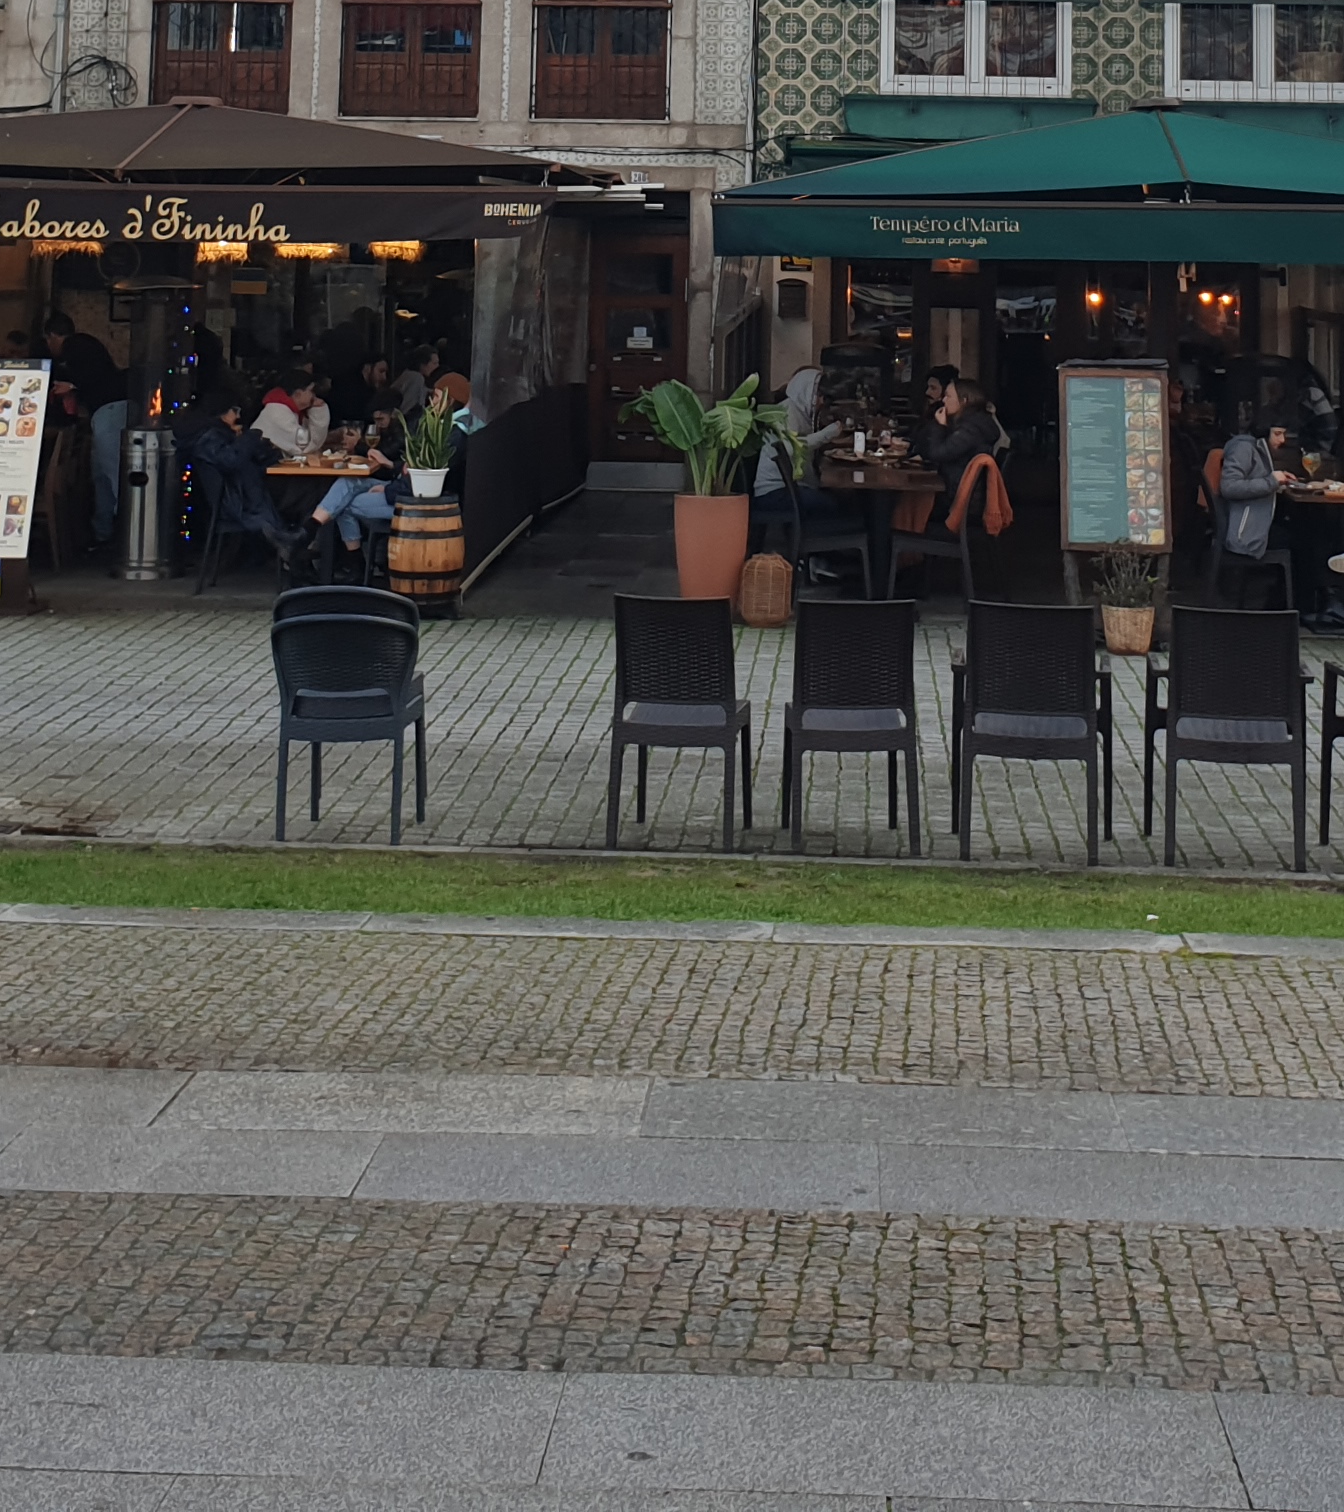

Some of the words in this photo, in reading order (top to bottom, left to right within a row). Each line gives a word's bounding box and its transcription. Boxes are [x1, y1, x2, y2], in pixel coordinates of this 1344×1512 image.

[122, 194, 290, 241] d'Fininha
[484, 204, 542, 216] BOHEMIA
[870, 216, 950, 234] Tempêro
[953, 216, 1020, 233] d'Maria
